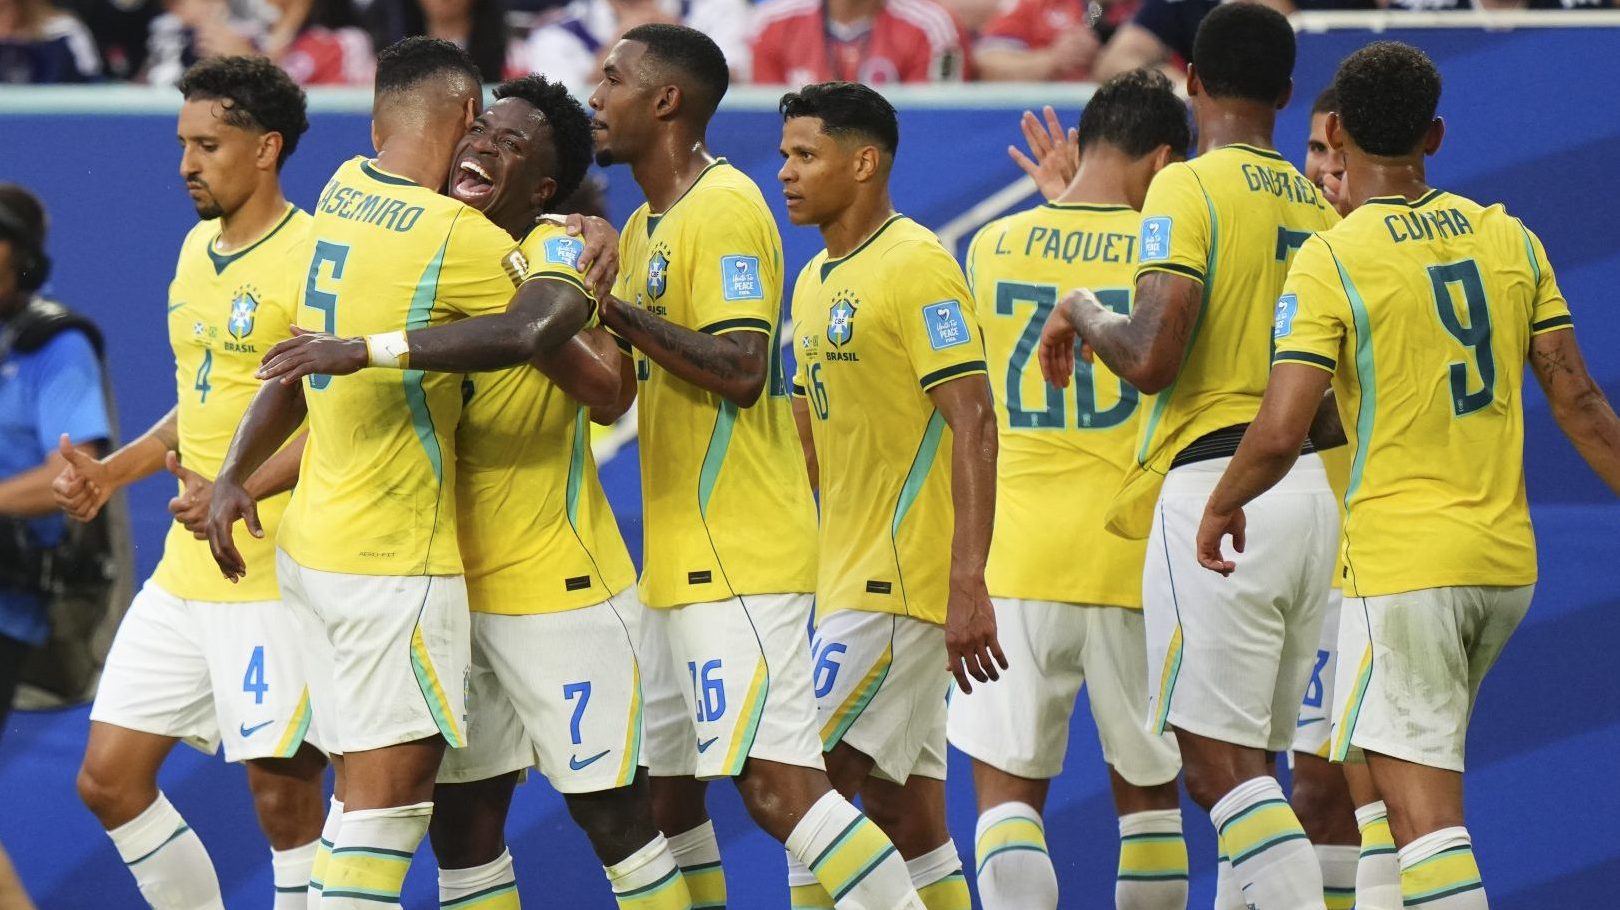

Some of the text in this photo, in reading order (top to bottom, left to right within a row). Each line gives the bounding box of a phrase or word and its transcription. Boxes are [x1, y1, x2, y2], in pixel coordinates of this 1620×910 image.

[317, 180, 425, 233] ASEMIRO
[1384, 208, 1474, 243] CUNHA
[994, 226, 1136, 264] L. PAQUET
[305, 240, 350, 389] 5
[1427, 259, 1495, 416] 9
[224, 342, 257, 353] BRASIL
[826, 351, 859, 361] BRASIL
[996, 281, 1140, 429] 20
[195, 349, 212, 403] 4
[243, 646, 269, 704] 4
[563, 681, 591, 744] 7
